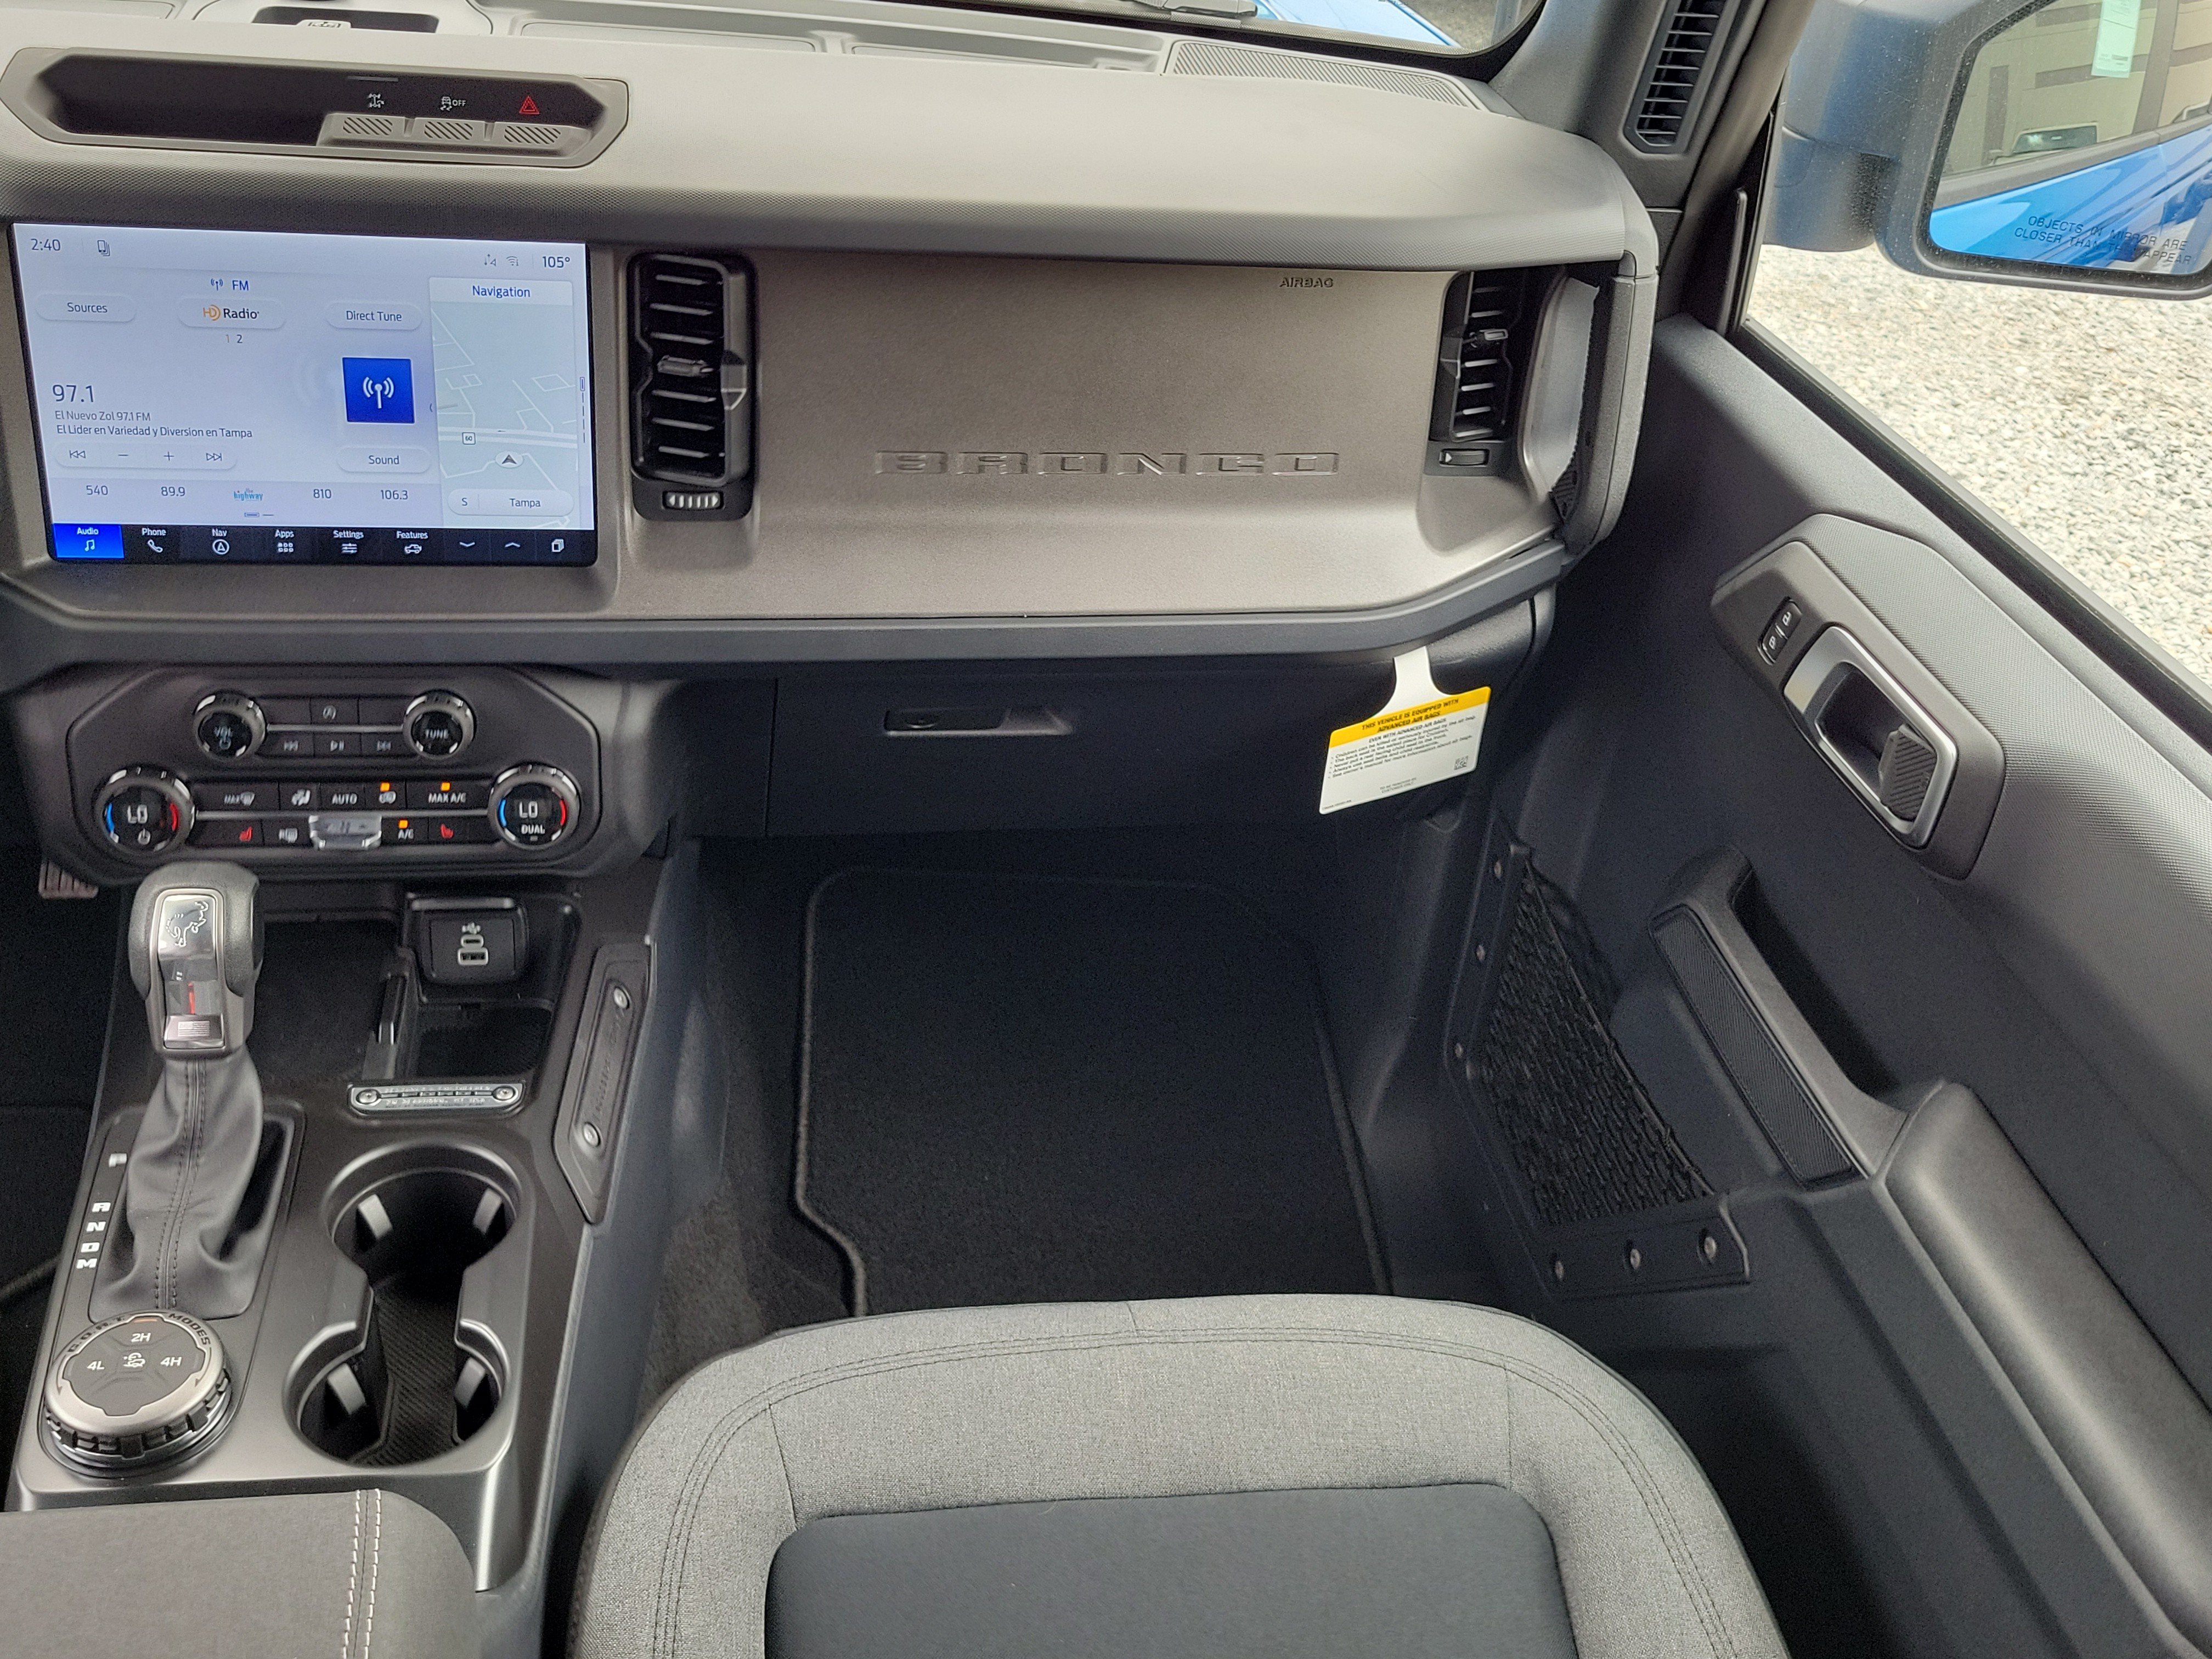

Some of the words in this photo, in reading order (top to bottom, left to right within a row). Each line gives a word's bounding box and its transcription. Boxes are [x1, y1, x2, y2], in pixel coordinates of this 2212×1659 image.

[2028, 216, 2084, 234] OBJECTS
[2163, 238, 2188, 251] ARE
[31, 239, 61, 251] 2:40
[2015, 228, 2062, 243] CLOSER
[2142, 250, 2192, 265] APPEAR
[543, 256, 571, 268] 105°
[232, 280, 249, 291] FM
[1279, 276, 1334, 288] AIRBAG
[472, 285, 531, 300] Navigation
[67, 302, 108, 313] Sources
[346, 311, 375, 321] Direct
[377, 312, 402, 322] Tune
[236, 335, 242, 343] 2
[52, 384, 95, 403] 97.1
[55, 411, 64, 420] El
[66, 411, 97, 421] Nuevo
[99, 411, 115, 421] Zol
[116, 411, 134, 421] 97.1
[136, 412, 151, 421] FM
[57, 425, 66, 435] El
[69, 425, 92, 435] Lider
[108, 426, 151, 436] Variedad
[153, 429, 159, 438] y
[160, 426, 204, 437] Diversion
[219, 428, 252, 439] Tampa
[369, 455, 400, 465] Sound
[876, 451, 1340, 476] BRONCO
[86, 486, 109, 496] 540
[161, 486, 185, 497] 89.9
[234, 490, 263, 501] highway
[313, 488, 332, 499] 810
[380, 490, 408, 500] 106.3
[461, 498, 467, 507] S
[509, 498, 541, 509] Tampa
[77, 527, 99, 535] Audio
[142, 528, 166, 537] Phone
[212, 529, 227, 538] Nav
[275, 529, 294, 539] Apps
[334, 530, 364, 540] Settings
[397, 531, 428, 540] Features
[425, 729, 450, 740] TUNE
[332, 793, 358, 805] AUTO
[428, 793, 449, 803] MAX
[450, 793, 466, 803] A/C
[519, 801, 538, 819] LO
[398, 828, 414, 839] A/C
[521, 824, 545, 834] DUAL
[87, 1221, 106, 1232] N
[81, 1242, 100, 1253] D
[76, 1258, 97, 1269] M
[168, 1313, 211, 1346] MODES
[131, 1333, 151, 1342] 2H
[87, 1361, 105, 1371] 4L
[161, 1356, 182, 1367] 4H
